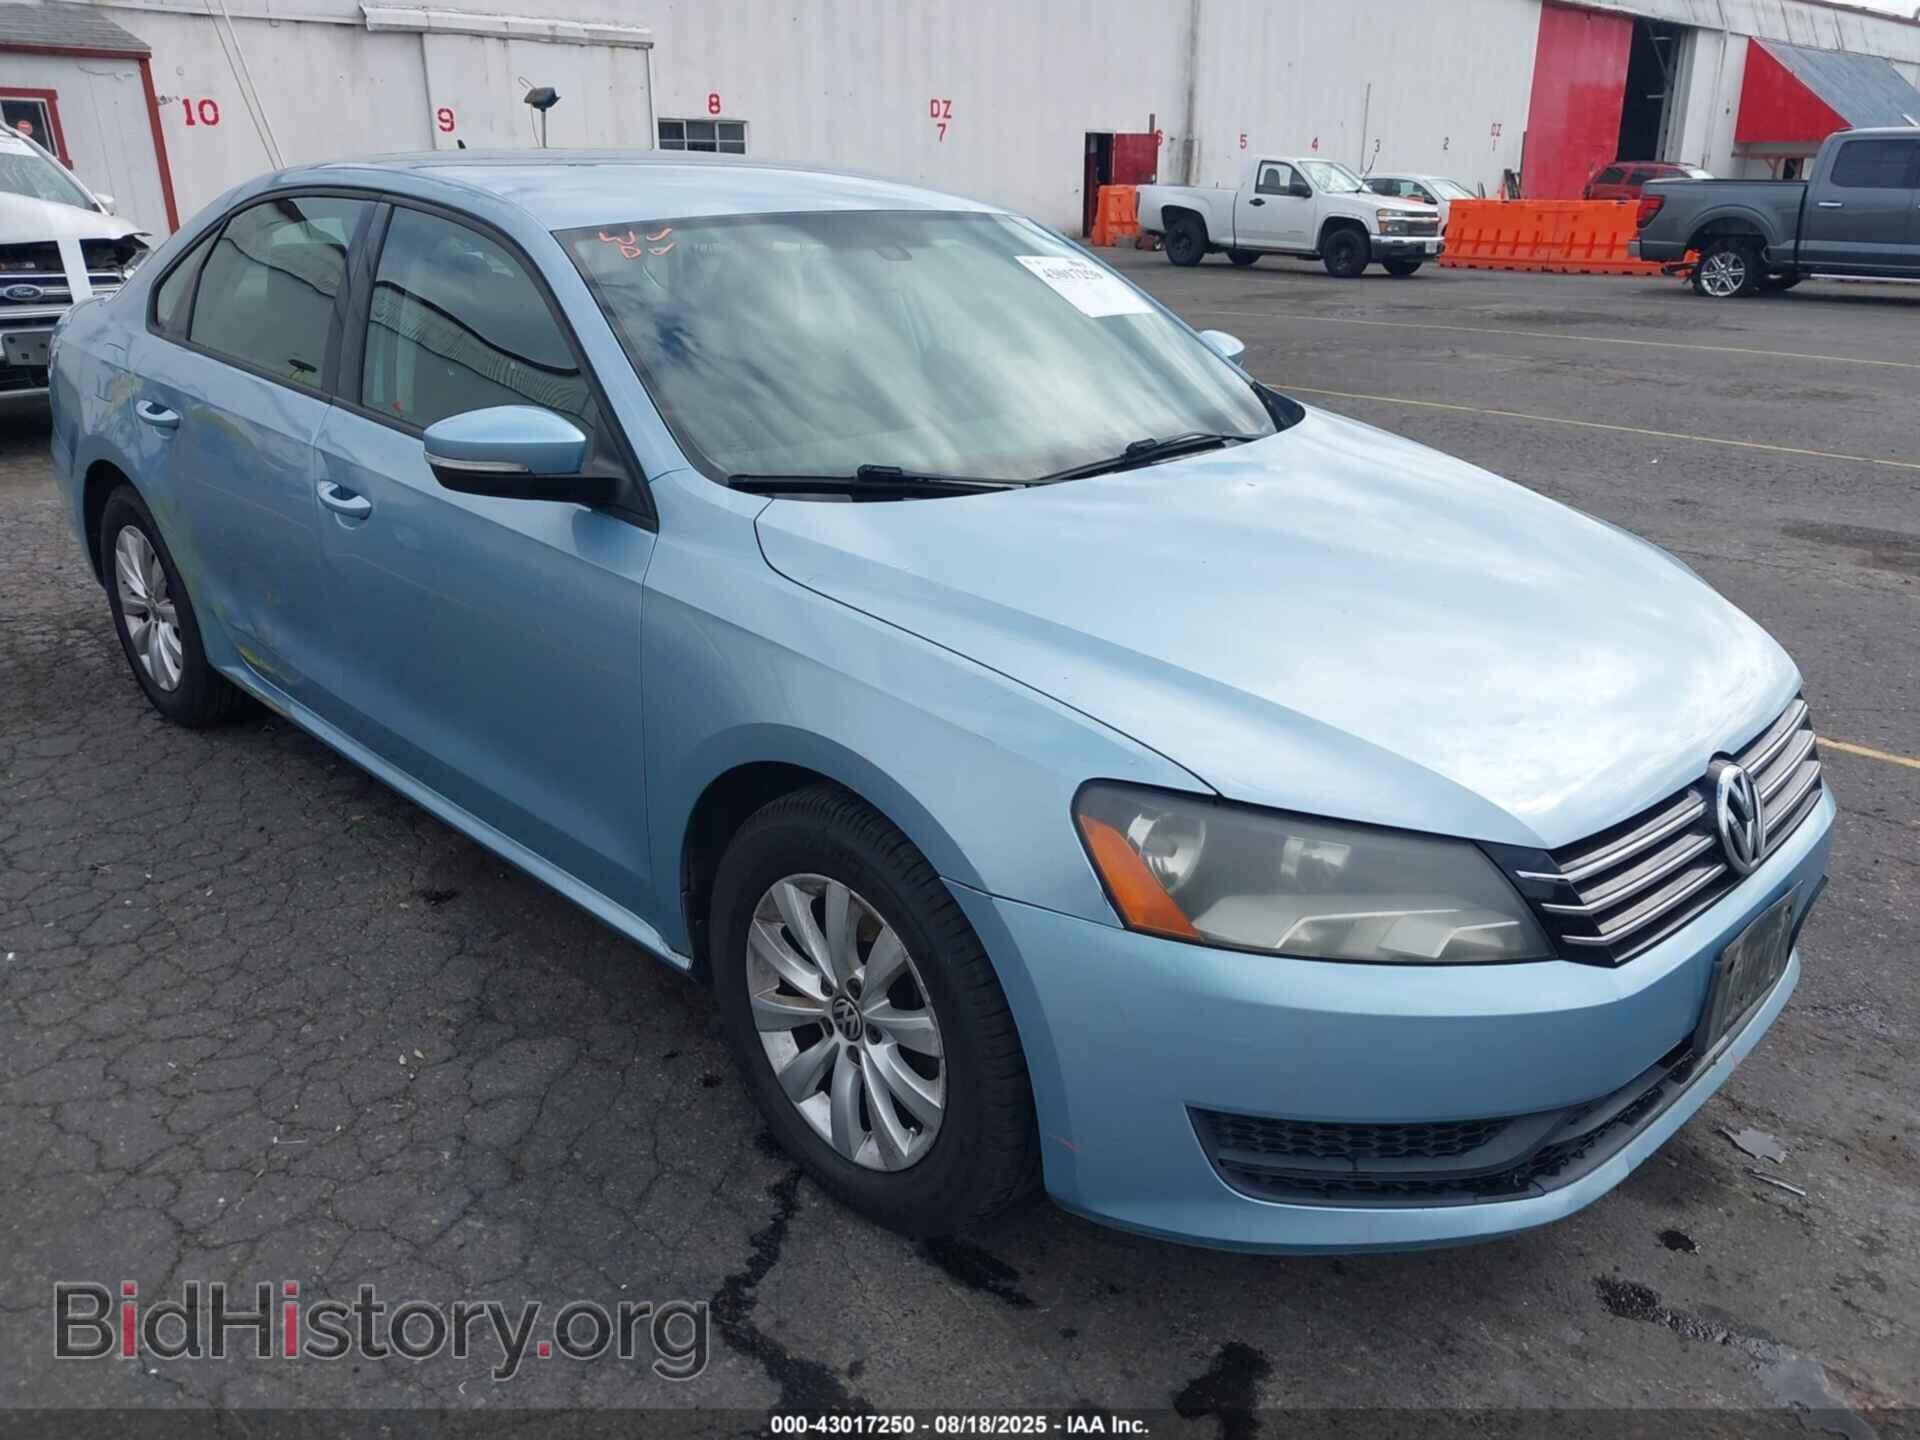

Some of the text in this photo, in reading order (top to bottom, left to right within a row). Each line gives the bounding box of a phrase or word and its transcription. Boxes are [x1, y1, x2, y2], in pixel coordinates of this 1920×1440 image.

[182, 98, 219, 126] 10
[708, 93, 721, 115] 8
[930, 98, 952, 119] DZ
[437, 107, 455, 132] 9
[936, 122, 947, 142] 7
[1239, 133, 1248, 150] 5
[1311, 136, 1319, 151] 4
[1442, 137, 1449, 151] 2
